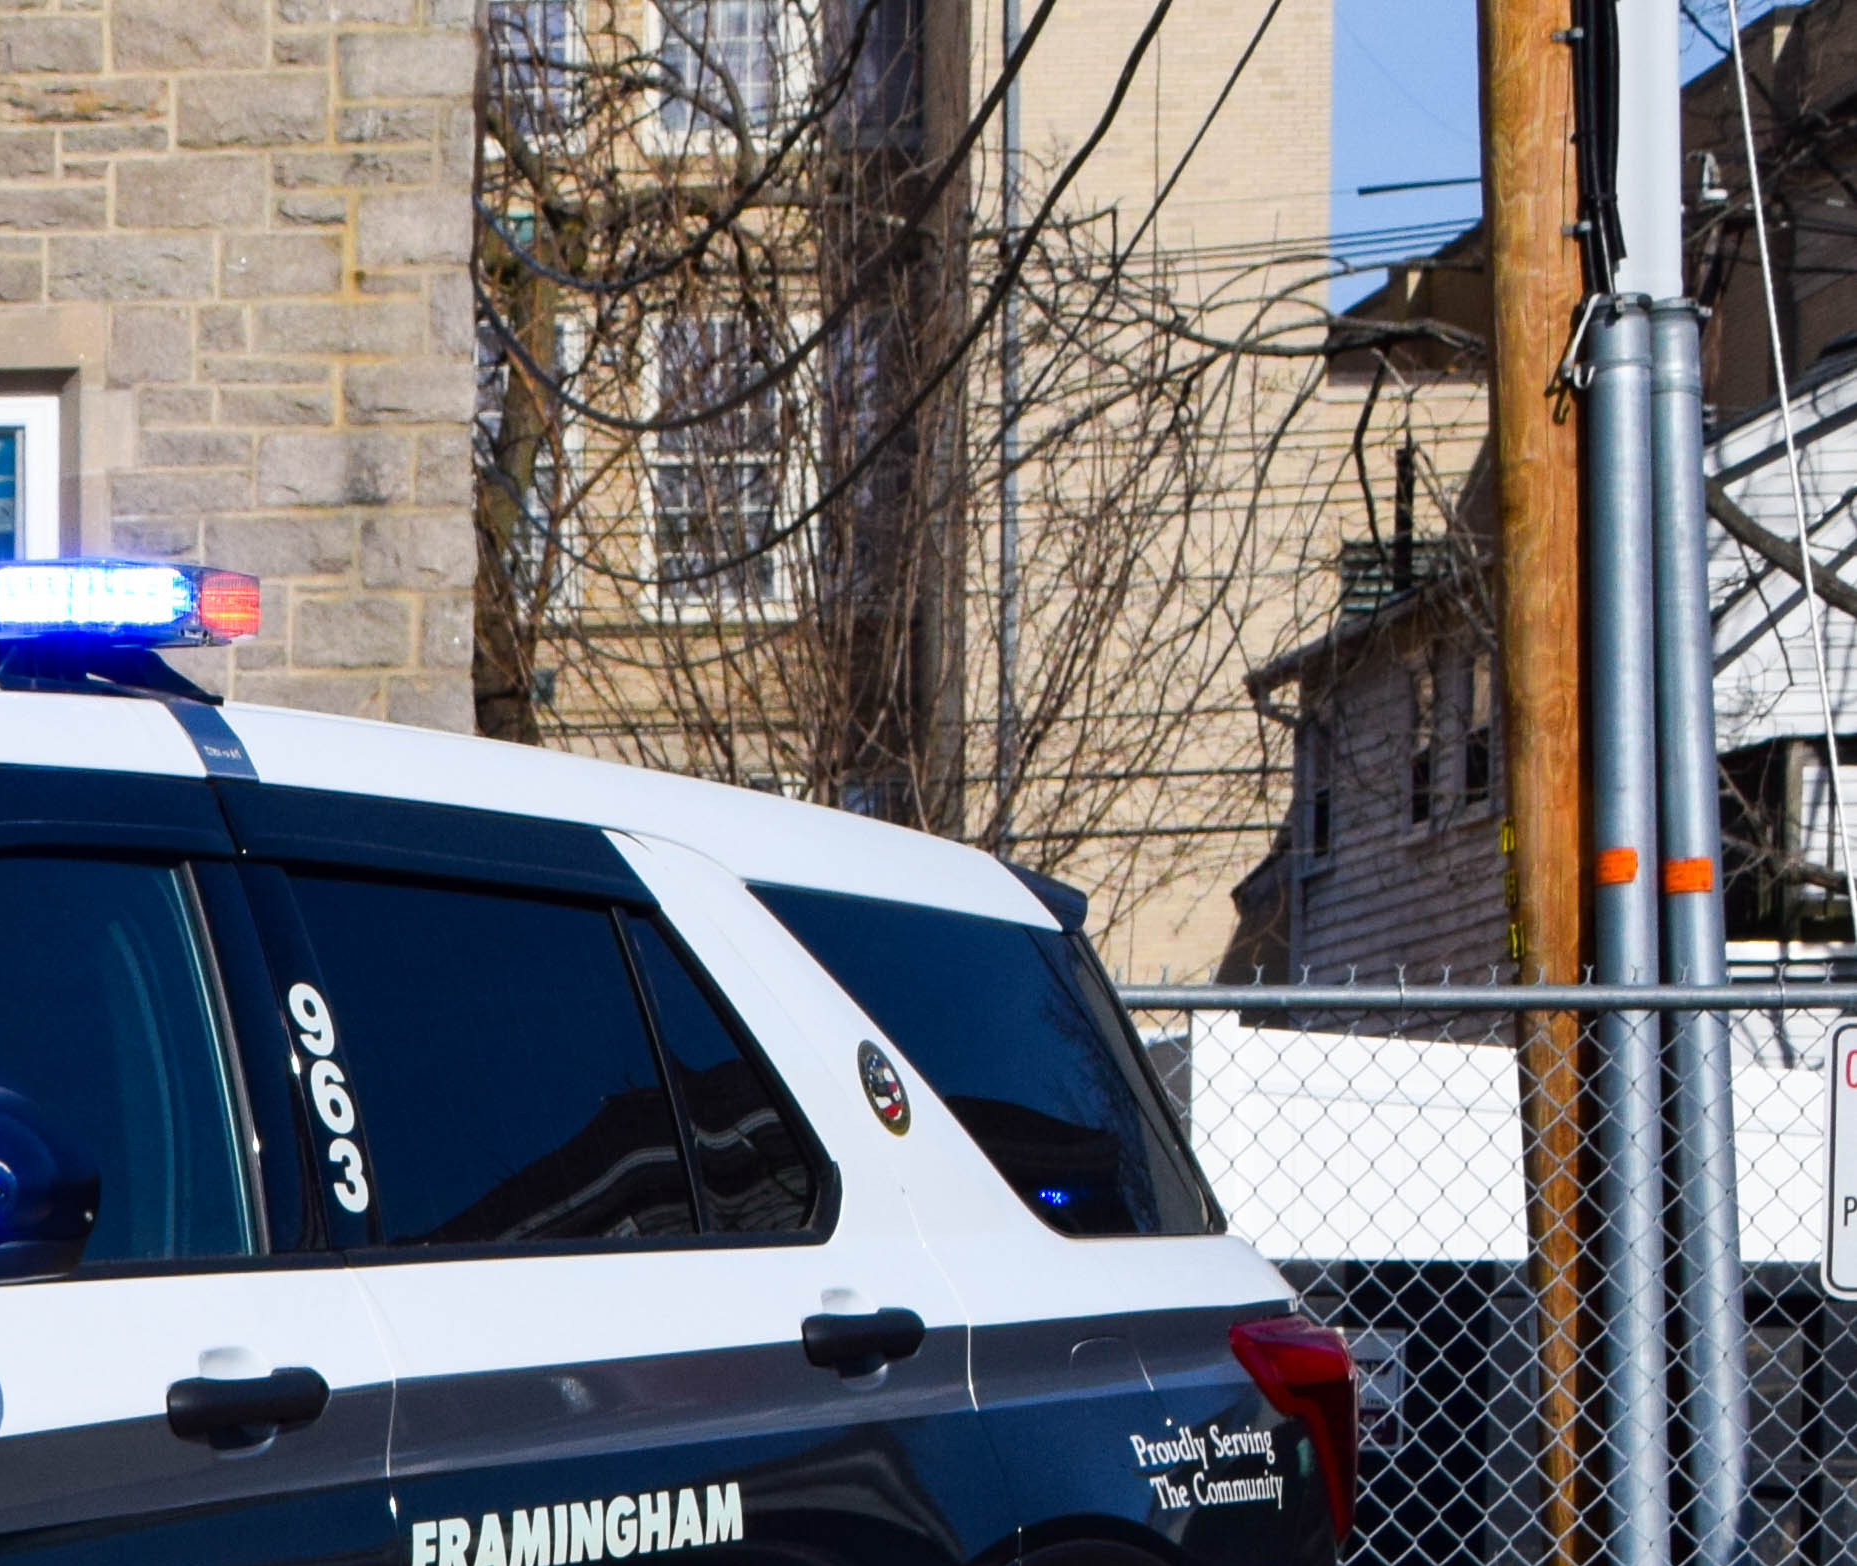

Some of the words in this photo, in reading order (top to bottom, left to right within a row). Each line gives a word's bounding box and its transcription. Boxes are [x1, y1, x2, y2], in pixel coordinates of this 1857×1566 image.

[289, 983, 369, 1213] 963
[1129, 1426, 1210, 1471] Proudly
[1209, 1424, 1276, 1465] Serving
[1149, 1474, 1191, 1510] The
[1192, 1470, 1283, 1510] Community
